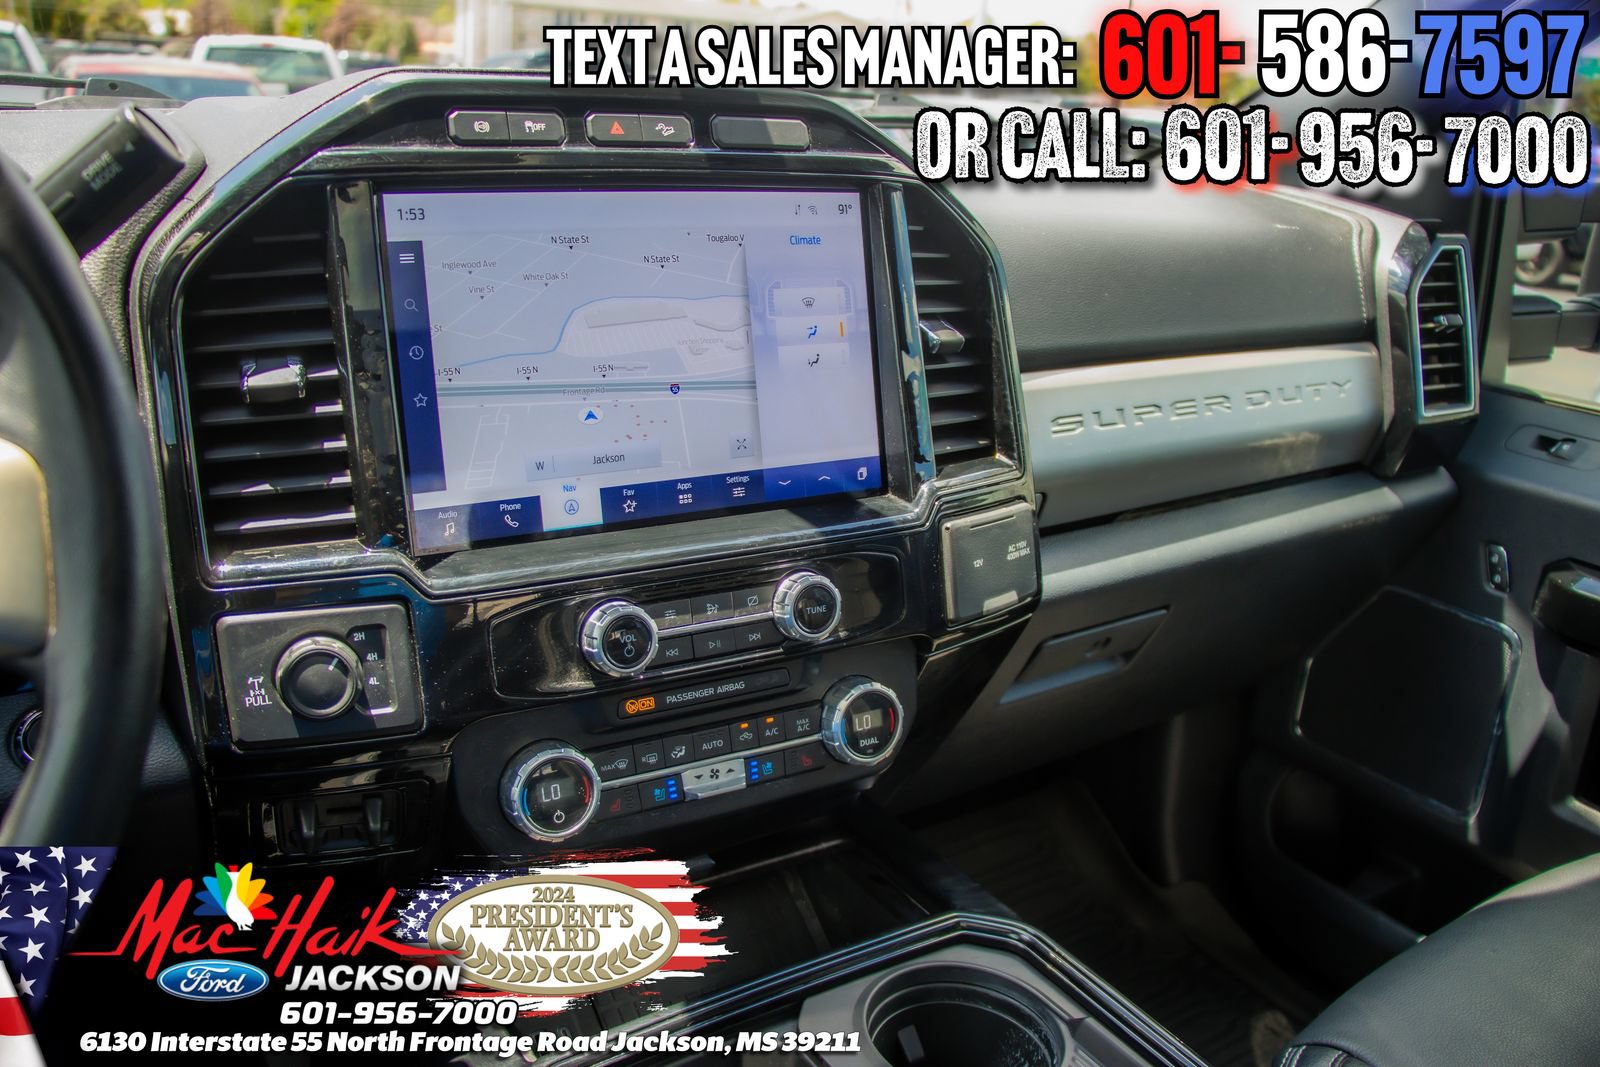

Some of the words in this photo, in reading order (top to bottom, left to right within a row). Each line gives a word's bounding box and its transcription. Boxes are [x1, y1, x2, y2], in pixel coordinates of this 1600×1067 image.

[533, 123, 546, 131] OFF
[397, 208, 425, 221] 1:53
[551, 236, 557, 244] N
[558, 235, 579, 244] State
[580, 235, 590, 244] St
[706, 234, 738, 243] Tougaloo
[789, 235, 821, 245] Climate
[651, 255, 670, 263] State
[671, 255, 680, 263] St
[442, 261, 481, 270] Inglewood
[482, 260, 496, 268] Ave
[523, 272, 544, 281] White
[546, 272, 559, 280] Oak
[560, 272, 569, 280] St
[468, 286, 485, 294] Vine
[486, 285, 495, 293] St
[434, 325, 442, 333] St
[517, 366, 532, 375] I-55
[533, 366, 539, 374] N
[593, 365, 608, 373] I-55
[608, 364, 614, 372] N
[563, 387, 595, 397] Frontage
[1050, 394, 1232, 437] SUPER
[1244, 379, 1352, 411] DUTY
[535, 461, 544, 471] W
[593, 452, 625, 465] Jackson
[726, 474, 750, 484] Settings
[563, 484, 576, 492] Nav
[677, 481, 692, 491] Apps
[623, 488, 635, 497] Fav
[500, 502, 521, 512] Phone
[438, 510, 458, 519] Audio
[806, 604, 828, 615] TUNE
[353, 632, 365, 642] 2H
[619, 633, 637, 643] VOL
[366, 652, 378, 661] 4H
[369, 677, 380, 686] 4L
[639, 699, 654, 710] ON
[666, 686, 715, 704] PASSENGER
[717, 681, 746, 695] AIRBAG
[245, 695, 272, 708] PULL
[796, 718, 809, 726] MAX
[765, 727, 779, 737] A/C
[797, 724, 811, 732] A/C
[702, 739, 724, 751] AUTO
[860, 736, 879, 747] DUAL
